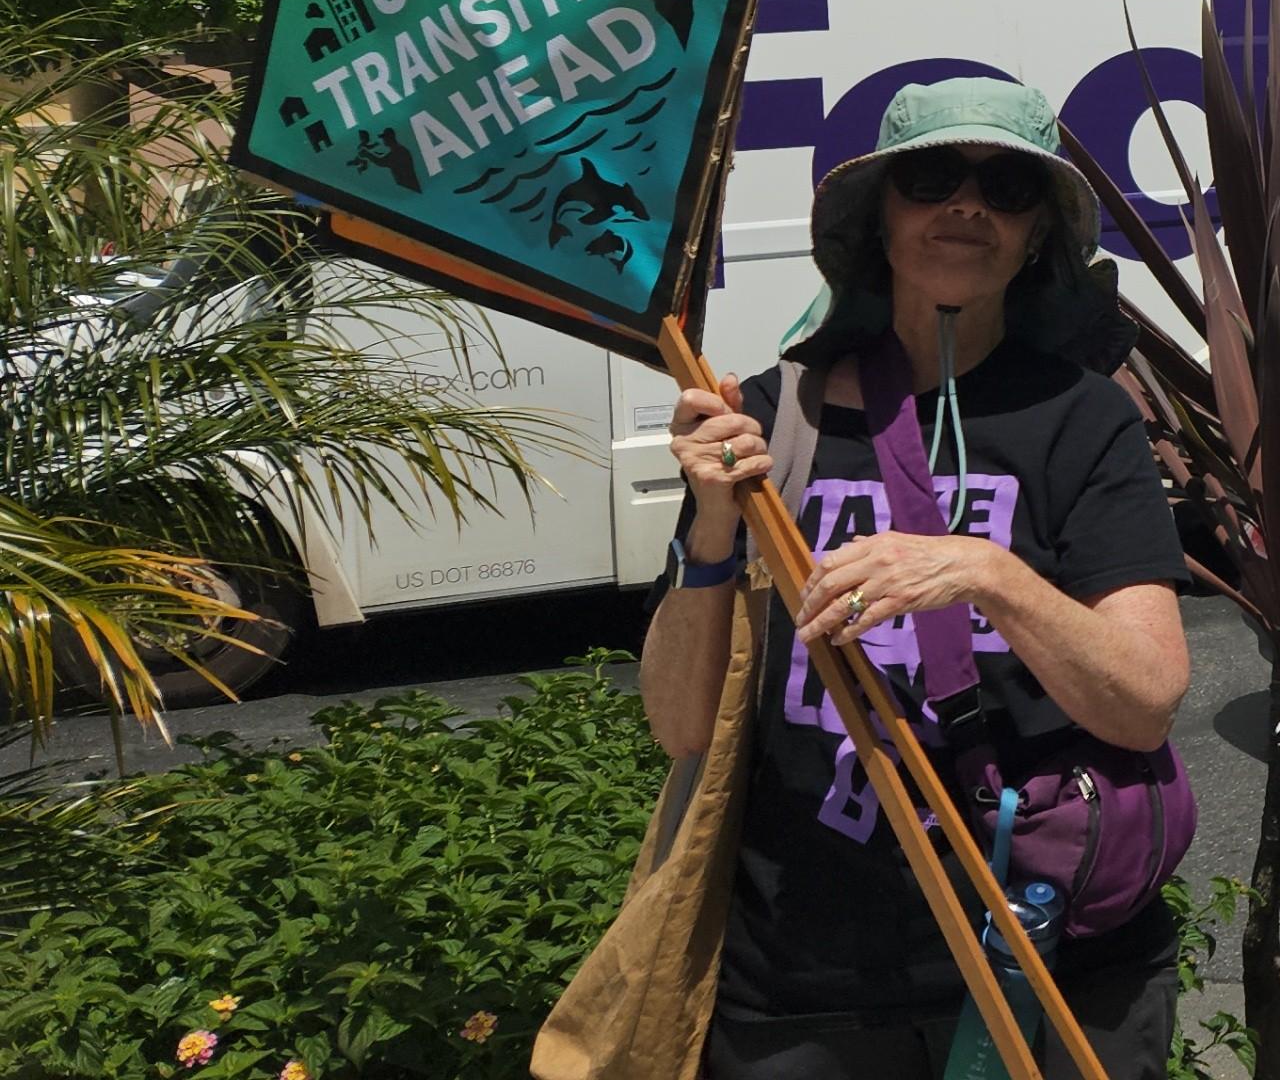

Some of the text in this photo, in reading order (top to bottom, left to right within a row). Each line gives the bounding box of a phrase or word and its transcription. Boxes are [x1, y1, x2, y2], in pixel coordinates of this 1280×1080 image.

[407, 5, 657, 177] AHEAD
[396, 558, 536, 590] US DOT 86876
